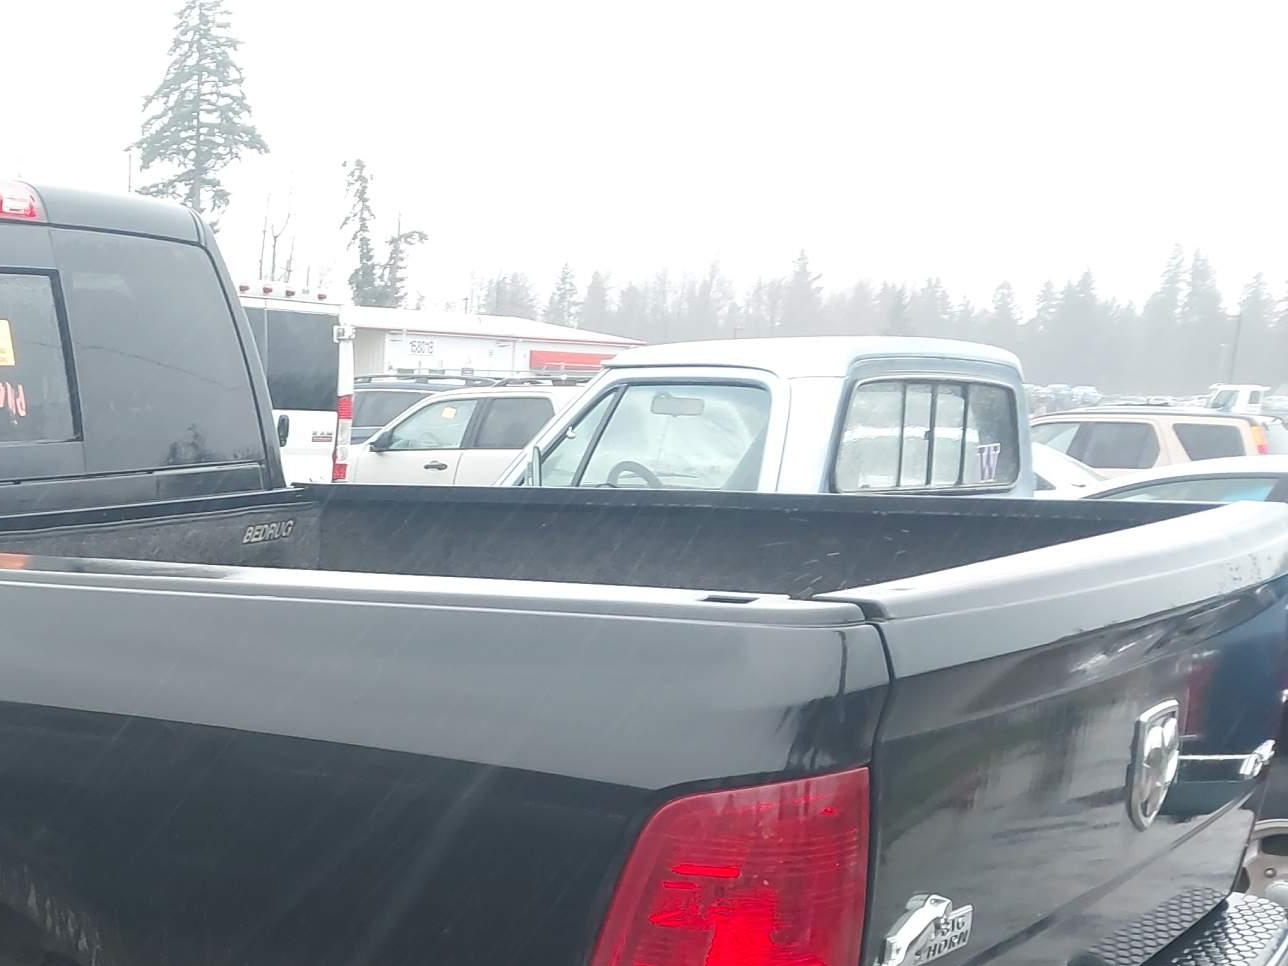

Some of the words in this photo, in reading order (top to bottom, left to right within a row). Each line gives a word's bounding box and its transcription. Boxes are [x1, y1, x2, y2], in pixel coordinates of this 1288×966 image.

[976, 443, 1001, 481] W
[243, 520, 294, 544] BEDRUG
[926, 930, 969, 959] HORN
